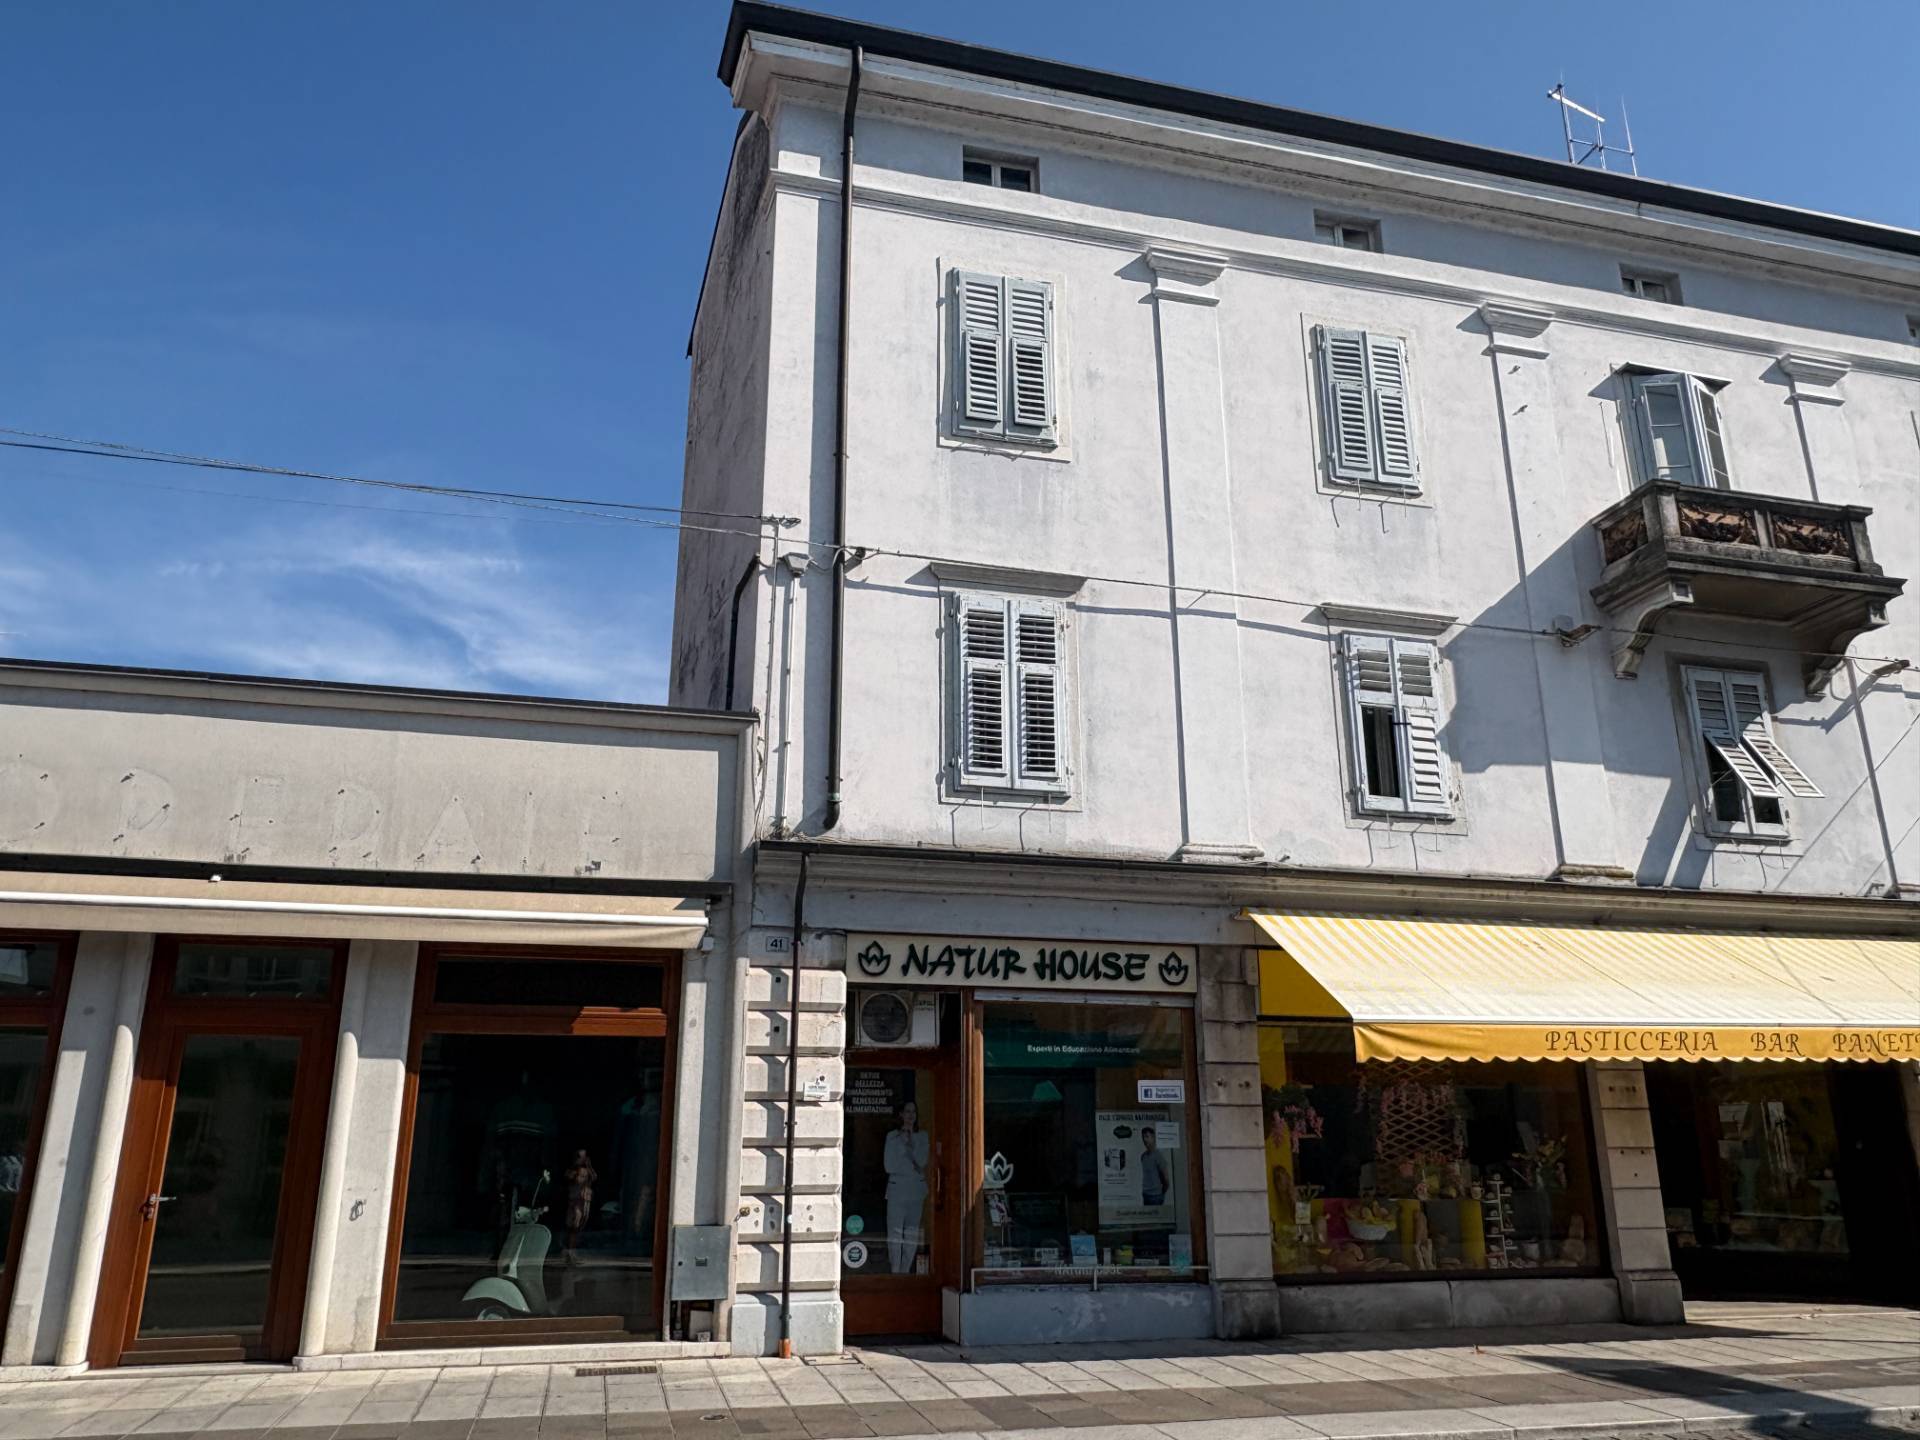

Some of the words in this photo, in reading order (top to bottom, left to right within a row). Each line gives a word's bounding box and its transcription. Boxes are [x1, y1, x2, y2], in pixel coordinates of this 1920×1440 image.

[770, 938, 783, 949] 41
[902, 943, 1026, 979] NATUR
[1033, 948, 1150, 982] HOUSE
[1545, 1030, 1718, 1055] PASTICCERIA
[1751, 1031, 1805, 1057] BAR
